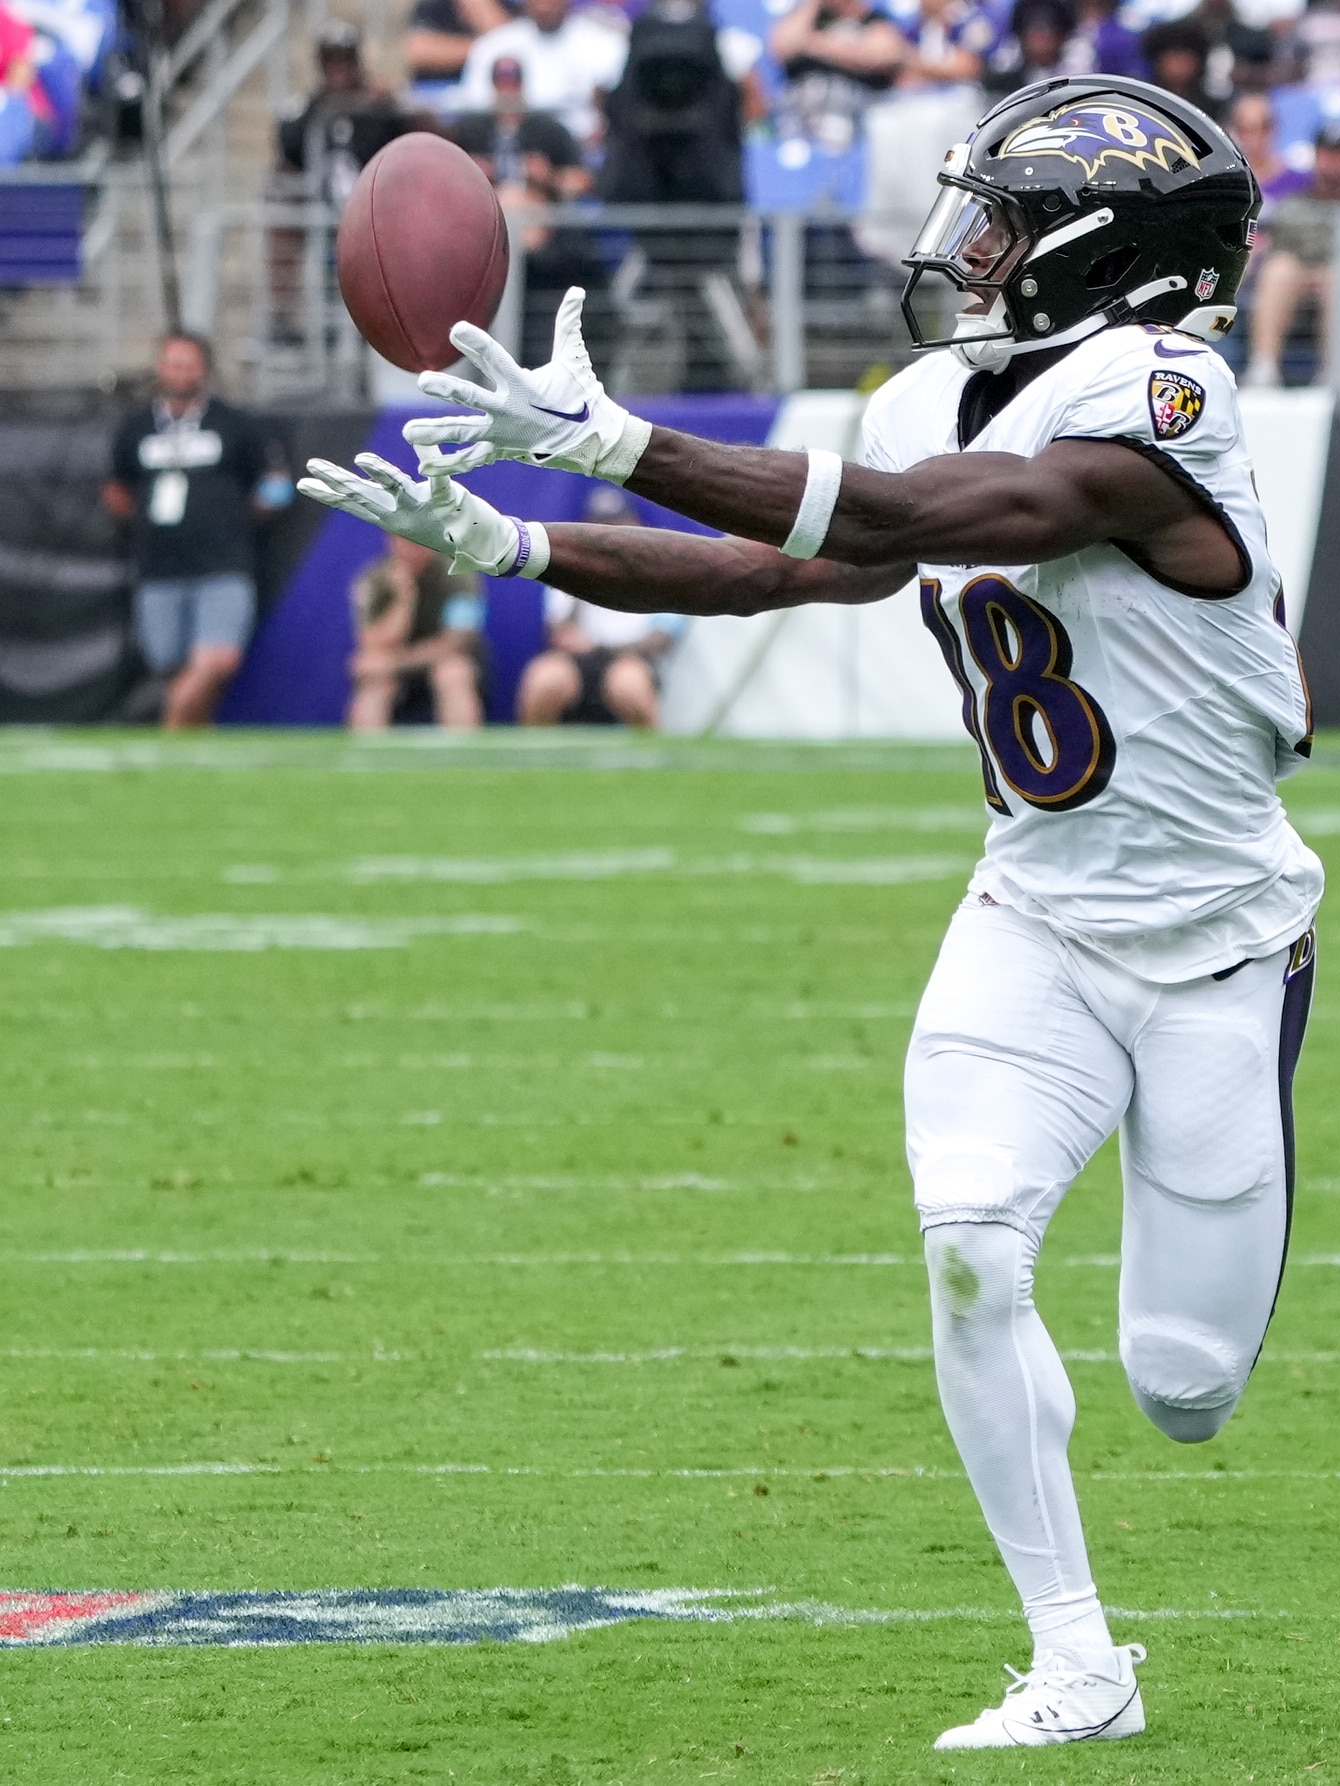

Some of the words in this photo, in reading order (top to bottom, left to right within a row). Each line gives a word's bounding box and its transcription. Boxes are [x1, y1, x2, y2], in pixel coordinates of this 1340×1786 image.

[1199, 282, 1212, 296] NFL
[1155, 372, 1202, 395] RAVENS
[920, 573, 1116, 817] 18
